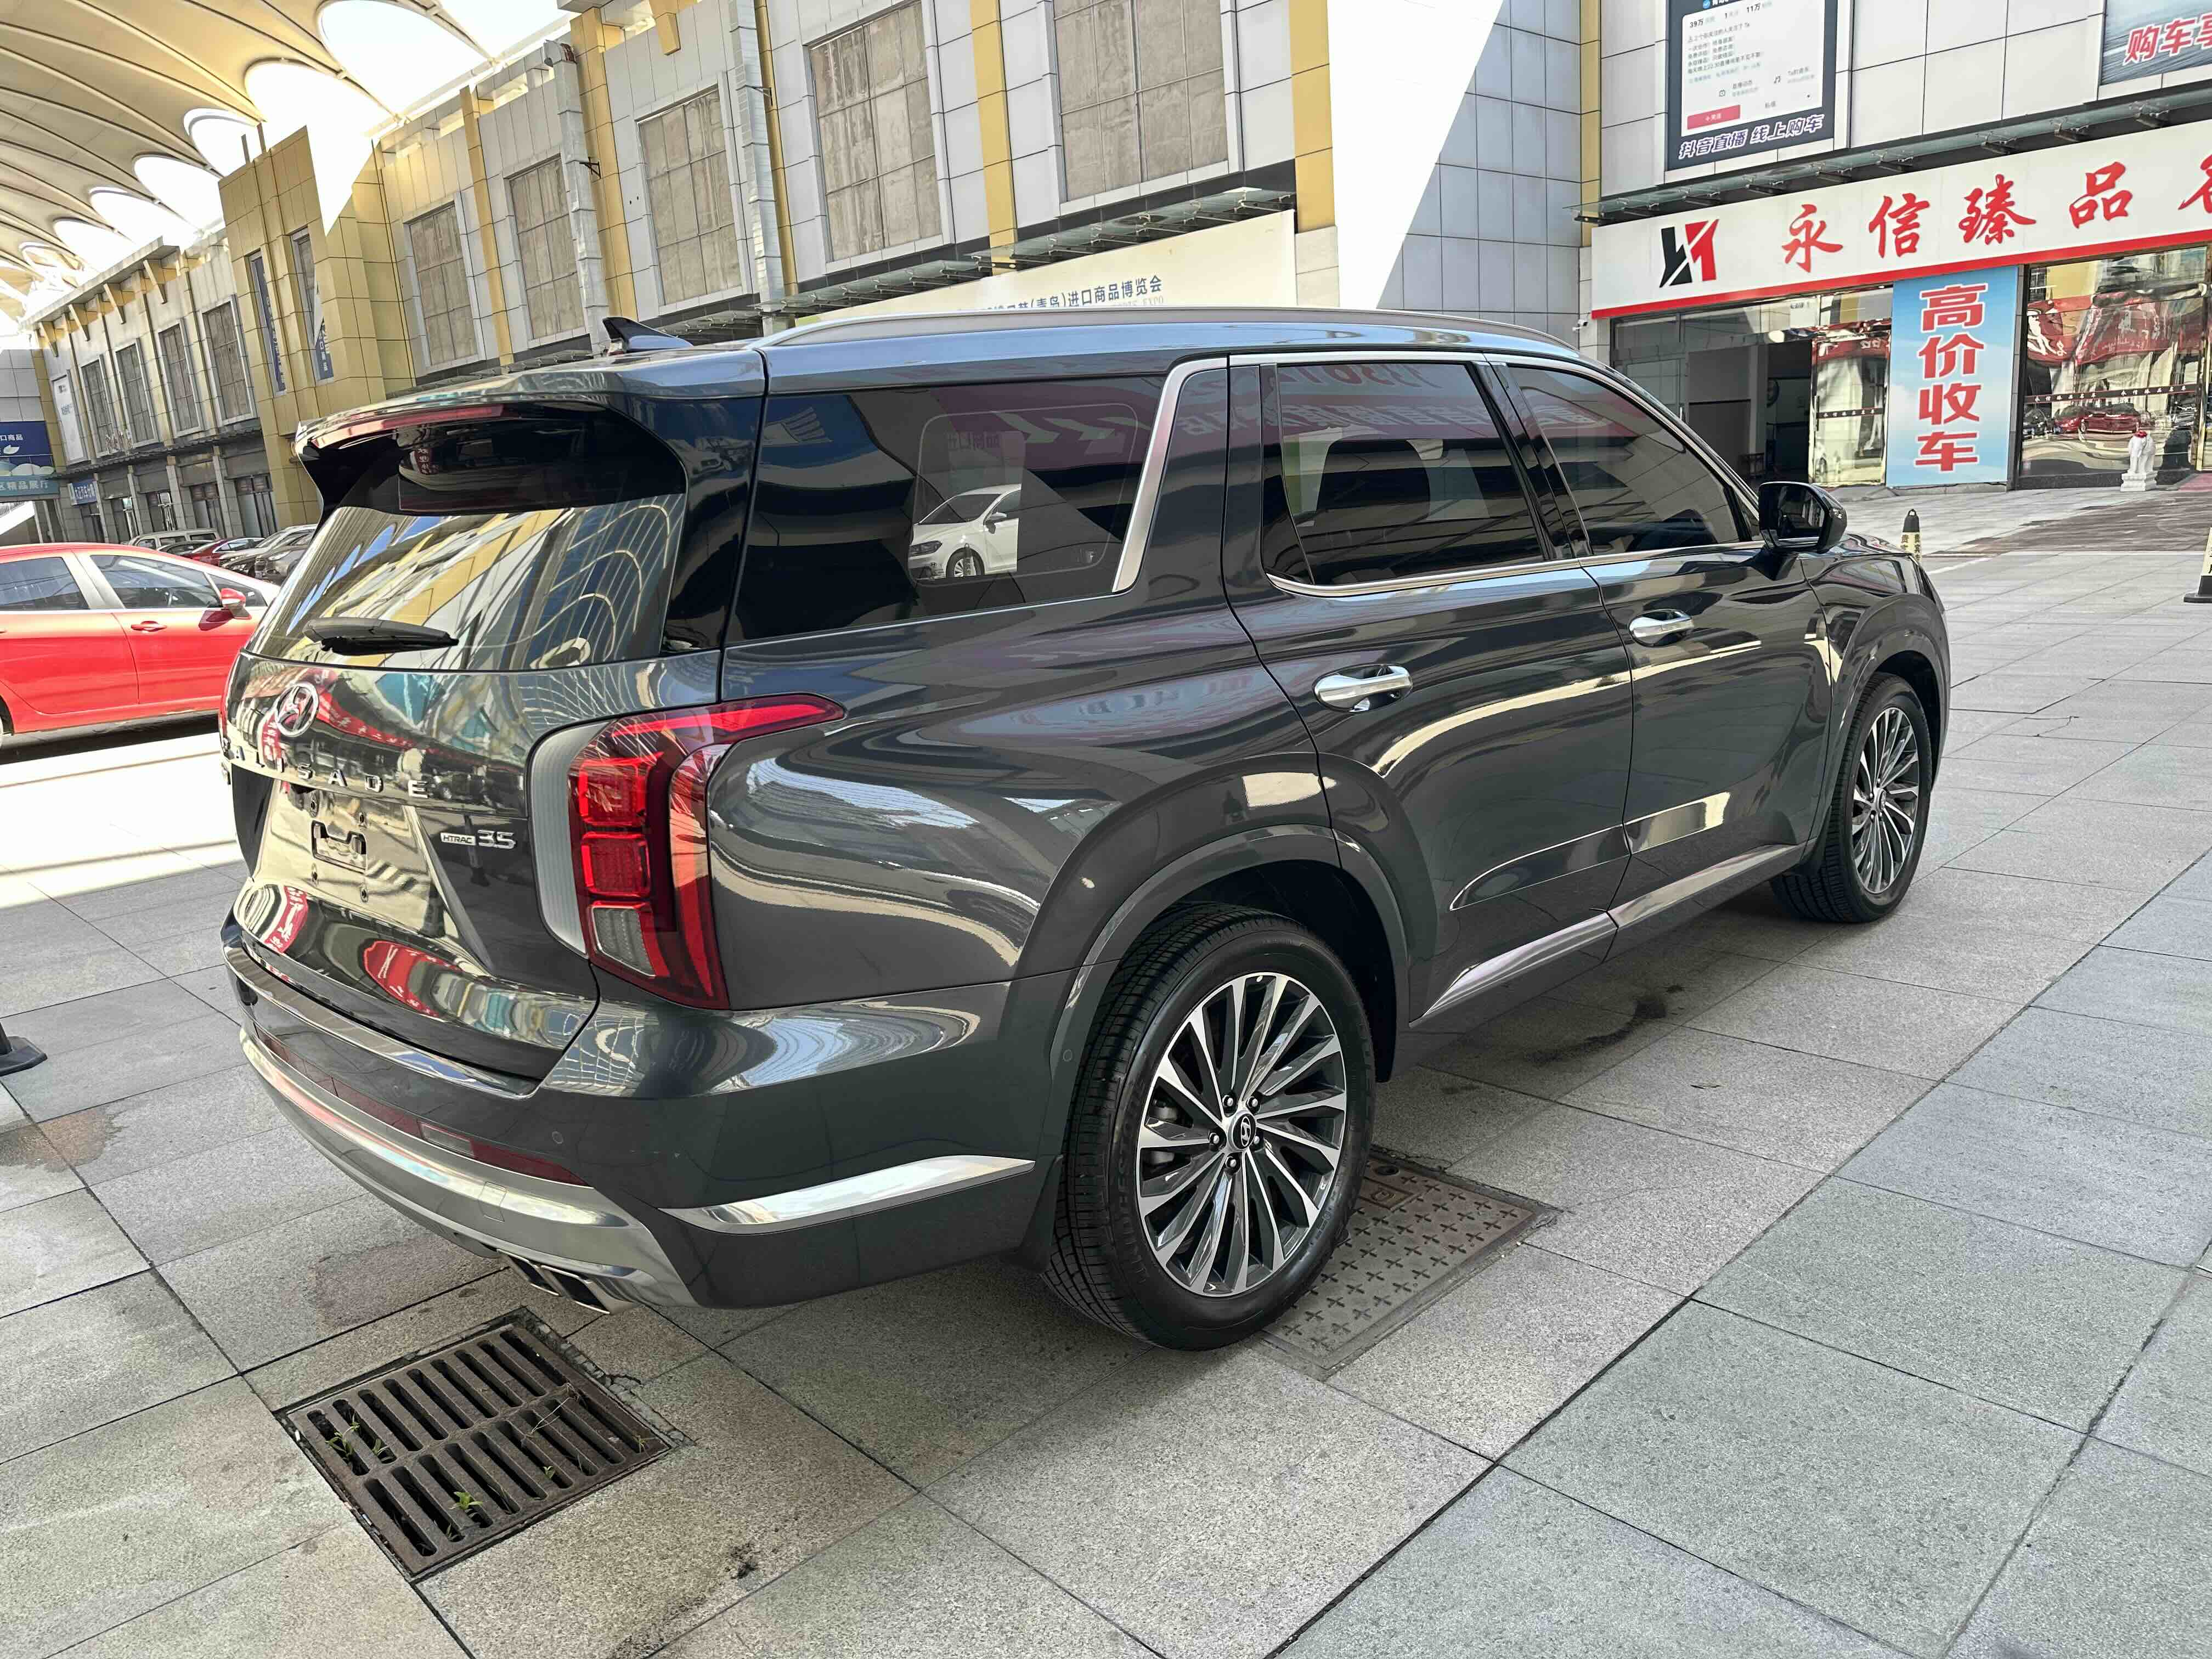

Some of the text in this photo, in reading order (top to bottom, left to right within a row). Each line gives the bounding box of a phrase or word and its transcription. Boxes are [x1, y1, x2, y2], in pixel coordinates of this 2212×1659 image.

[1678, 114, 1825, 160] 抖音直播 线上购车
[986, 274, 1162, 308] (青岛)进口商品博览会
[1915, 281, 1988, 473] 高价收车
[442, 834, 473, 844] HTRAC
